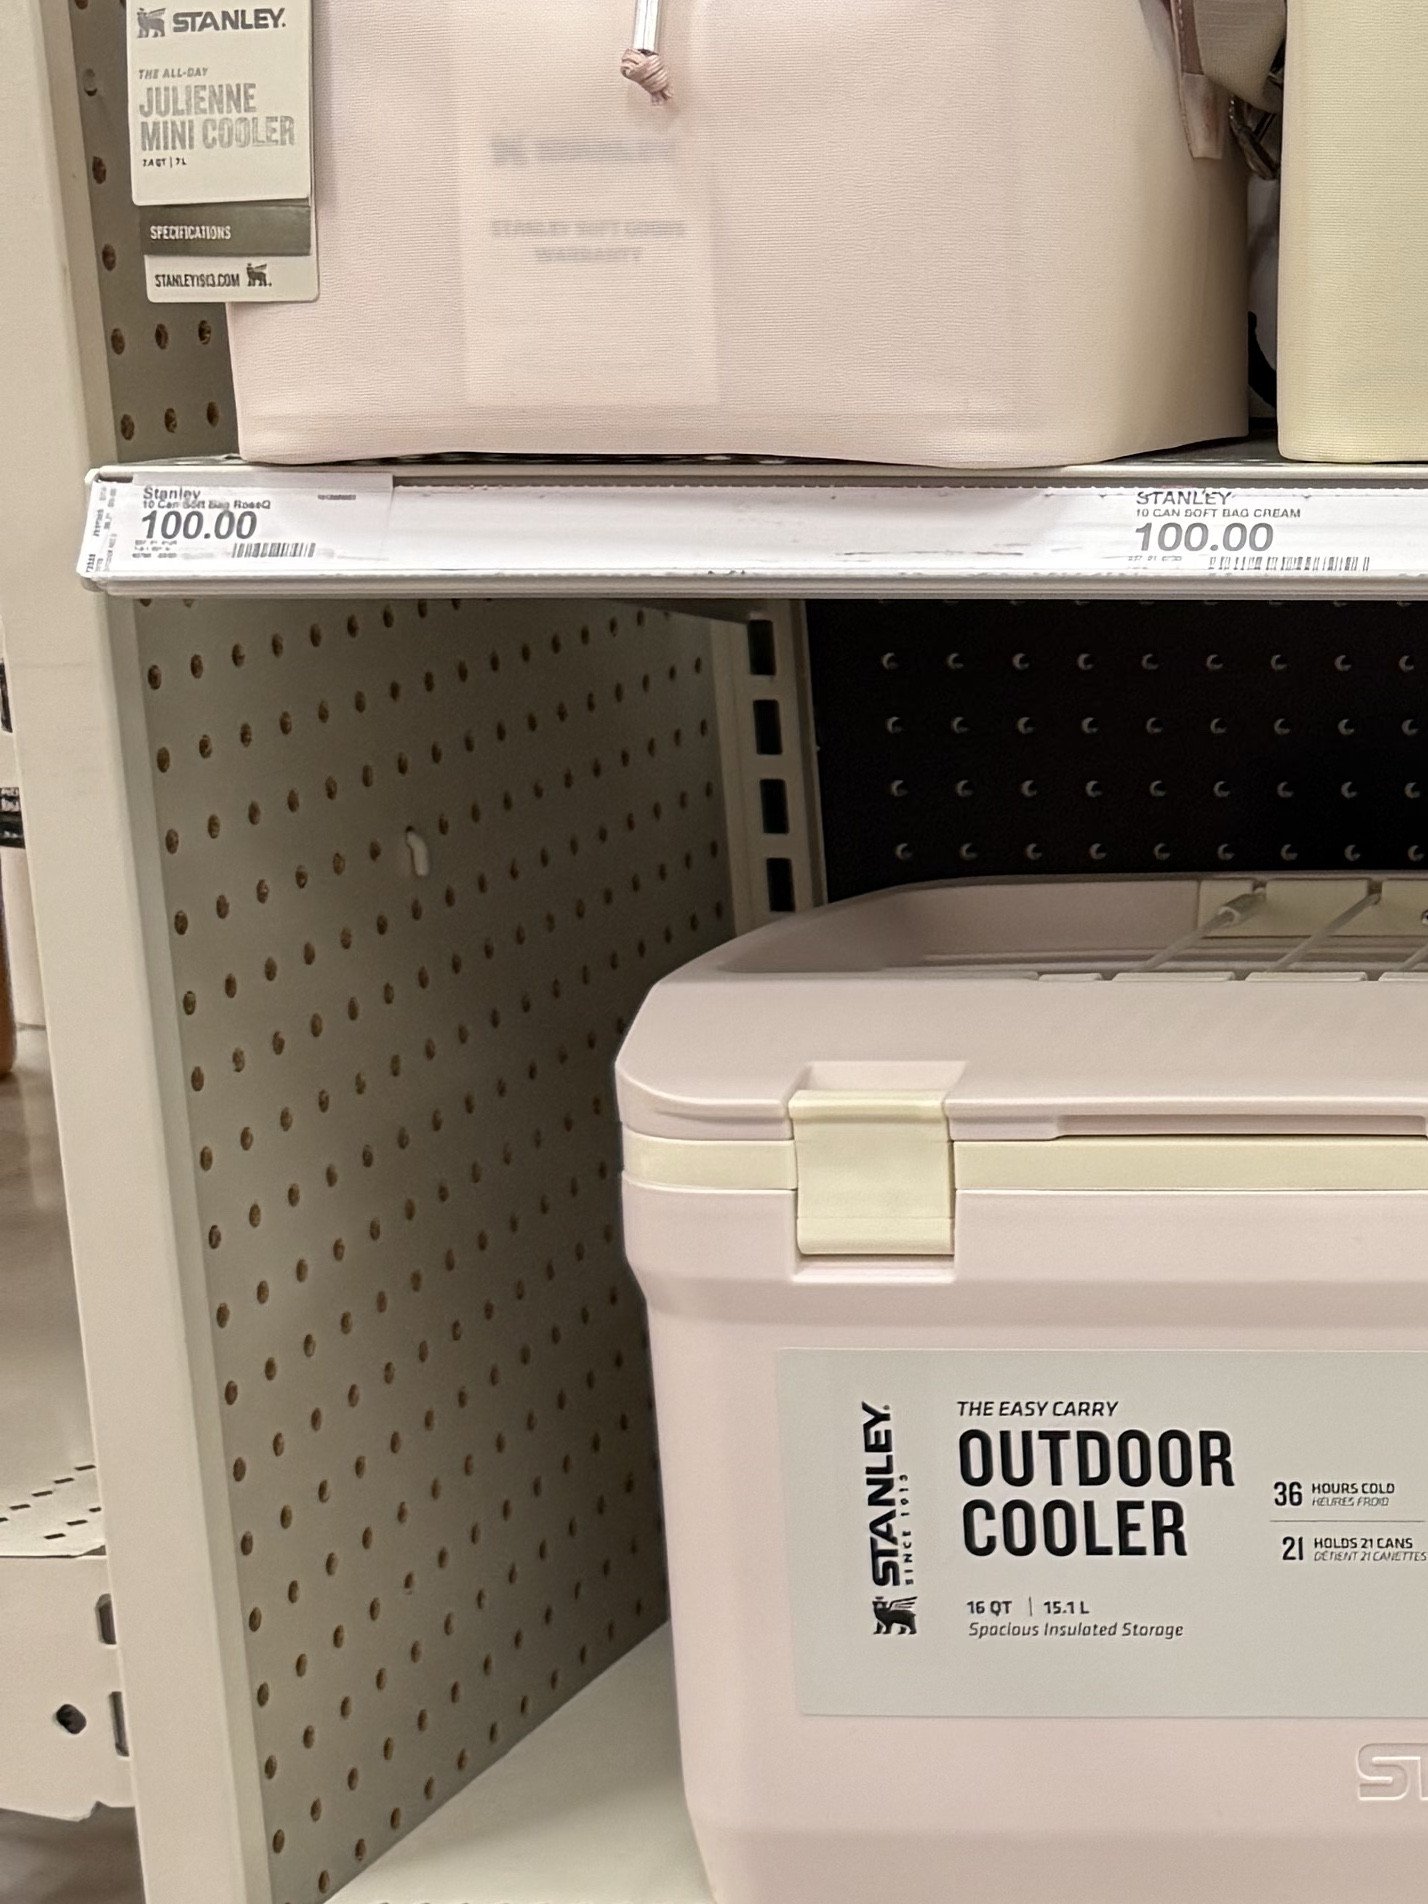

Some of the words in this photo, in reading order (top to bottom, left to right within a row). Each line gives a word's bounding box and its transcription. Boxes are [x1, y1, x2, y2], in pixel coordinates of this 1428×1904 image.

[172, 7, 287, 34] STANLEY
[137, 68, 160, 80] THE
[162, 67, 209, 79] ALL-DAY
[138, 83, 258, 118] JULIENNE
[140, 119, 195, 152] MINI
[202, 114, 296, 150] COOLER
[149, 224, 231, 241] SPECIFICATIONS
[143, 487, 200, 502] Stanley
[1136, 491, 1232, 505] STANLEY
[141, 510, 258, 540] 100.00
[1136, 508, 1149, 518] 10
[1153, 508, 1180, 518] CAN
[1184, 508, 1218, 518] SOFT
[1222, 508, 1249, 518] BAG
[1253, 508, 1301, 518] CREAM
[1135, 522, 1274, 552] 100.00
[957, 1401, 994, 1417] THE
[998, 1401, 1048, 1417] EASY
[1052, 1401, 1119, 1417] CARRY
[958, 1428, 1235, 1488] OUTDOOR
[861, 1400, 901, 1587] STANLEY
[1273, 1481, 1303, 1507] 36
[1311, 1482, 1358, 1494] HOURS
[1361, 1482, 1395, 1494] COLD
[962, 1499, 1188, 1557] COOLER
[1282, 1536, 1303, 1561] 21
[1314, 1537, 1358, 1549] HOLDS
[1360, 1537, 1373, 1549] 21
[1376, 1537, 1413, 1549] CANS
[966, 1600, 986, 1614] 16
[989, 1600, 1012, 1617] QT
[1043, 1600, 1077, 1615] 15.1
[1080, 1601, 1090, 1614] L
[968, 1621, 1039, 1640] Spacious
[1044, 1621, 1117, 1637] Insulated
[1122, 1622, 1184, 1640] Storage
